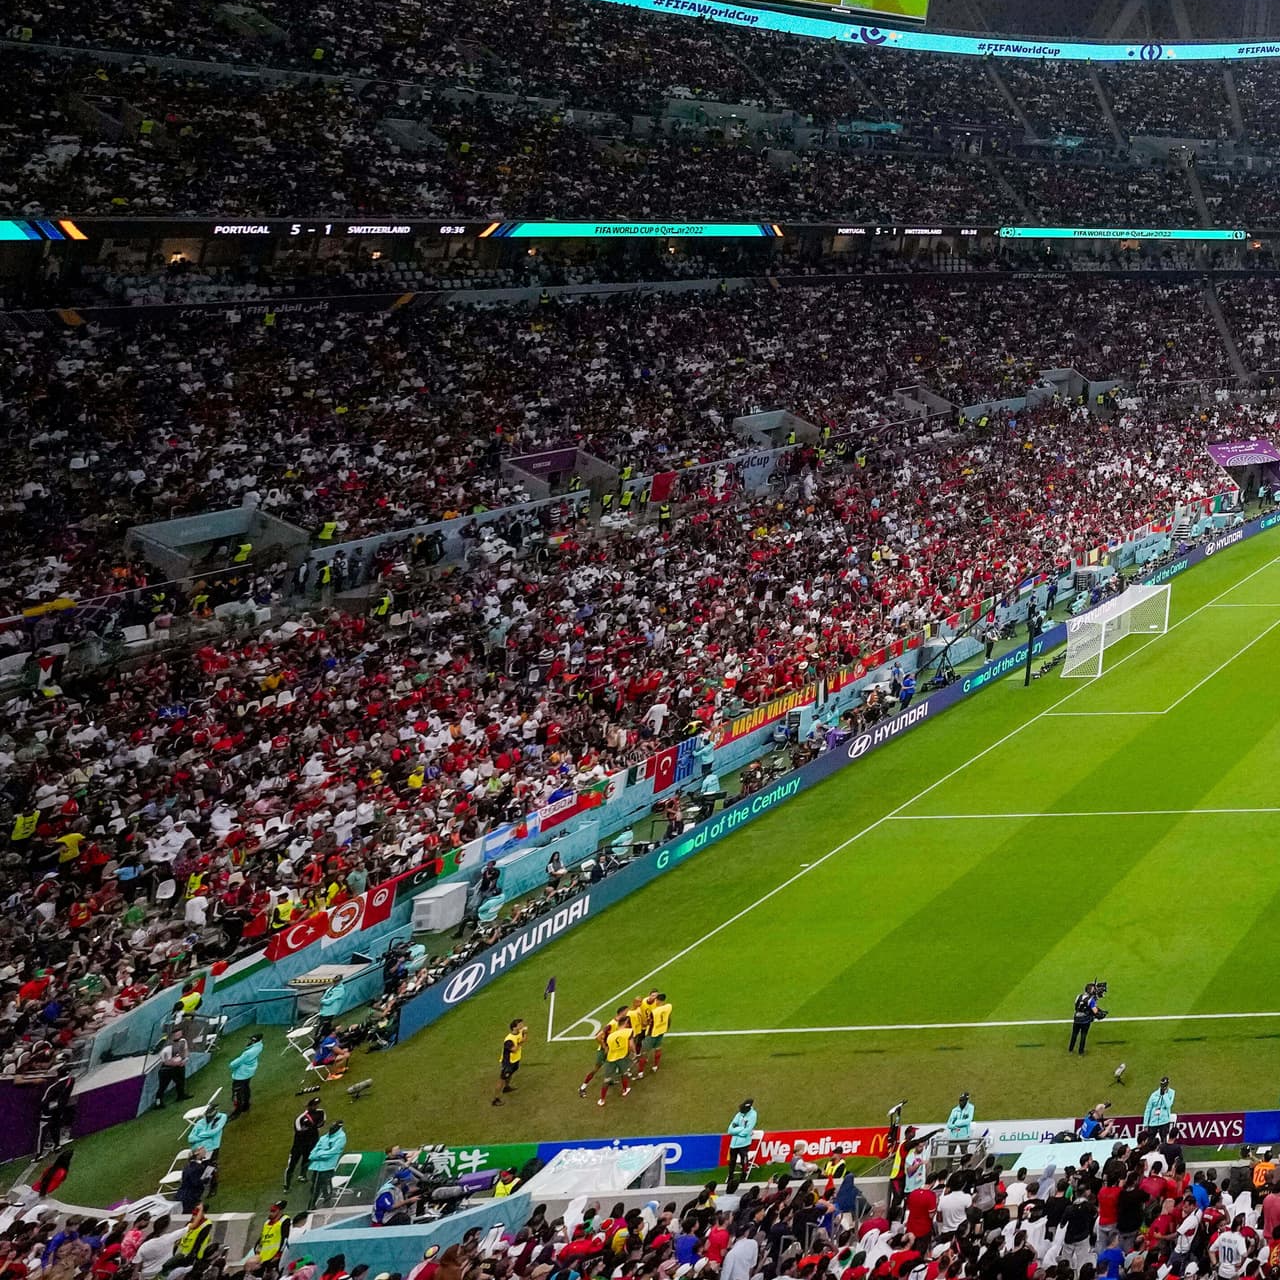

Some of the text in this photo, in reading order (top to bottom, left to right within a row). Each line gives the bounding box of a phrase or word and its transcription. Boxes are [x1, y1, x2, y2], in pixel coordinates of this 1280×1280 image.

[978, 42, 1061, 56] #FIFAWorldCup
[214, 225, 465, 235] PORTUGAL 5 1 SWITZERLAND 69:36
[874, 702, 929, 745] HYUNDAI
[711, 817, 727, 839] of
[727, 808, 750, 829] the
[751, 776, 802, 814] Century
[490, 894, 591, 976] HYUNDAI
[761, 1136, 862, 1159] We Deliver
[1221, 1245, 1234, 1264] 10
